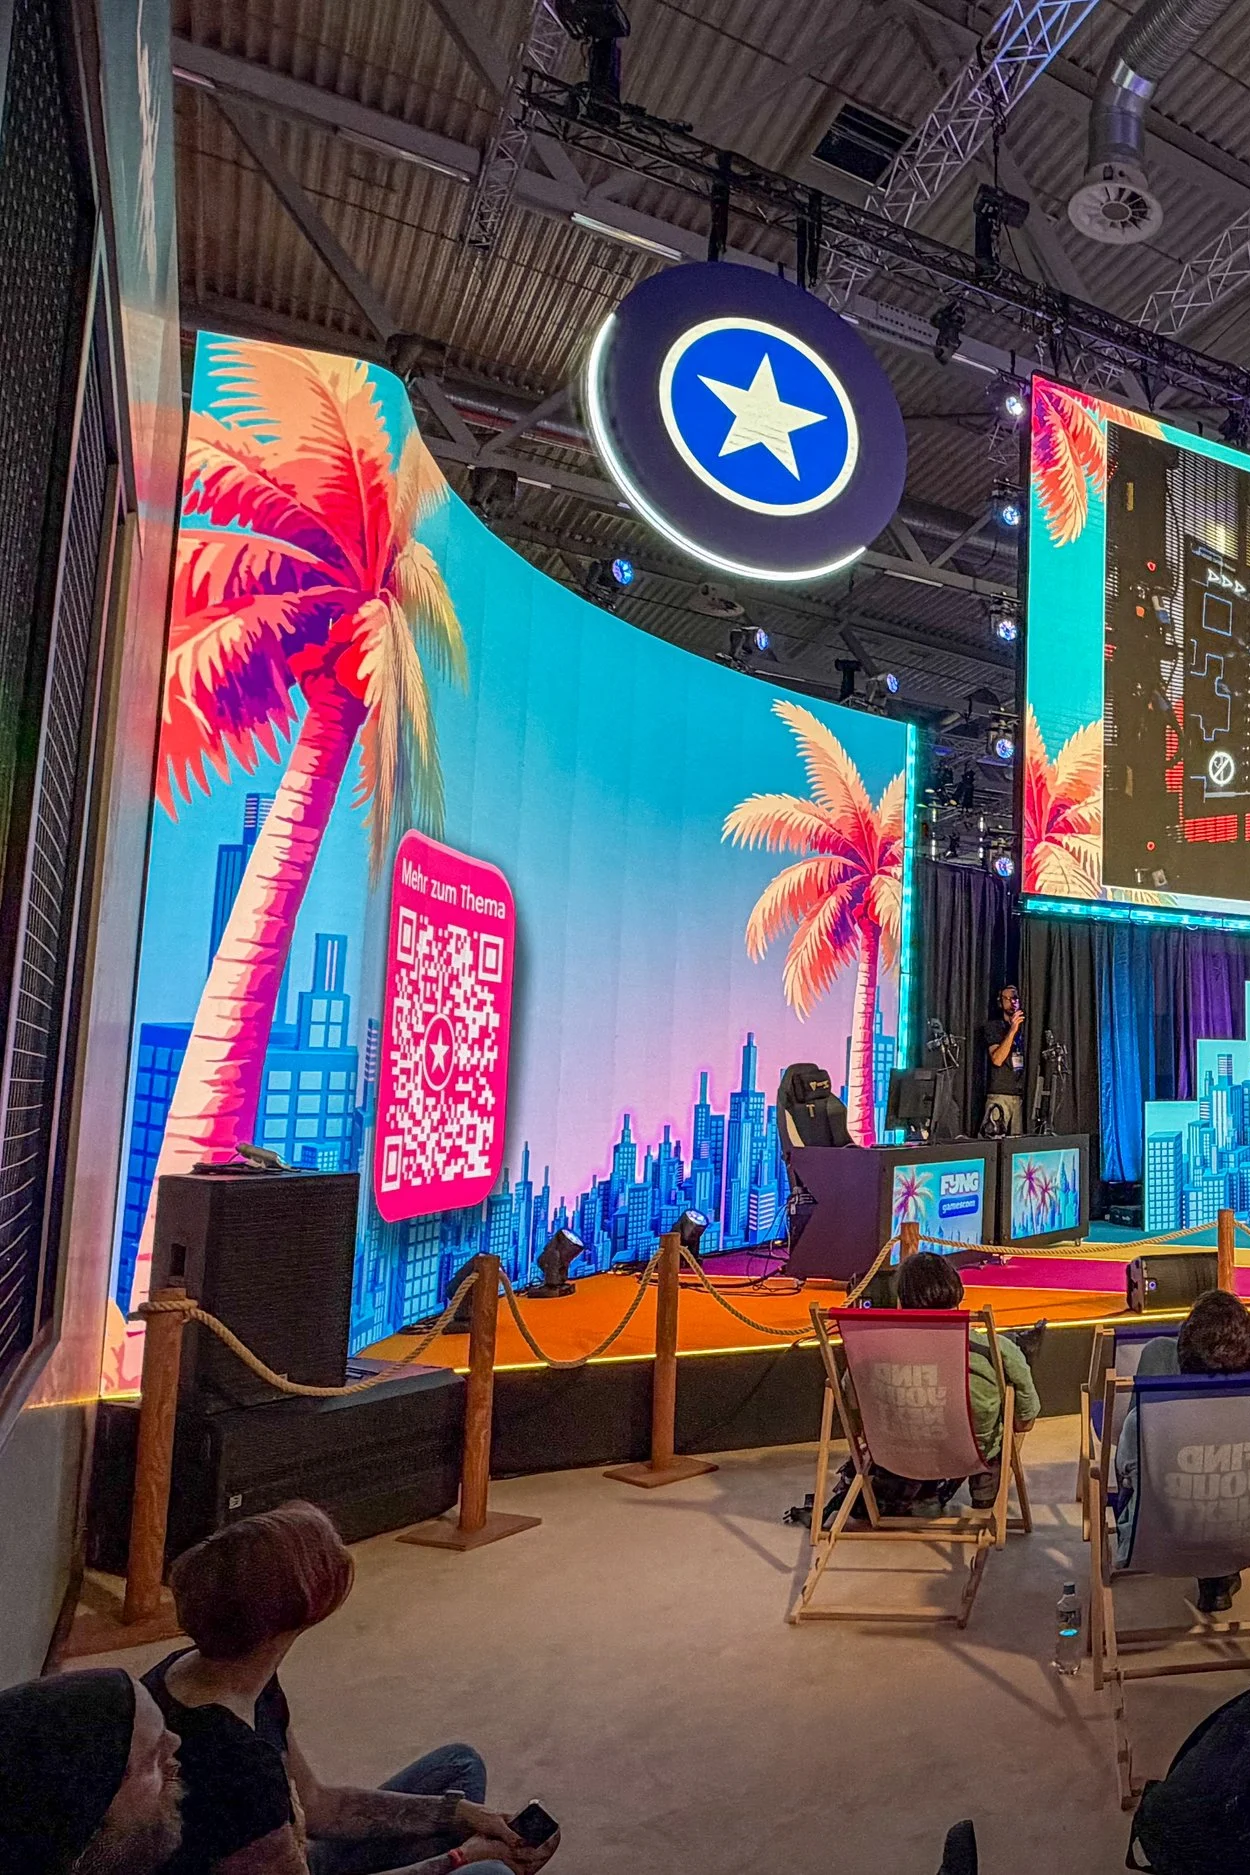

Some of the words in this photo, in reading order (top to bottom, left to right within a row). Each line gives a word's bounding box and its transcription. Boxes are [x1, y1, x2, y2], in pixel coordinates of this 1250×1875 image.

[401, 858, 428, 893] Mehr
[430, 878, 457, 905] zum
[461, 884, 505, 918] Thema
[940, 1171, 979, 1195] FYNG
[942, 1199, 976, 1214] gamescom
